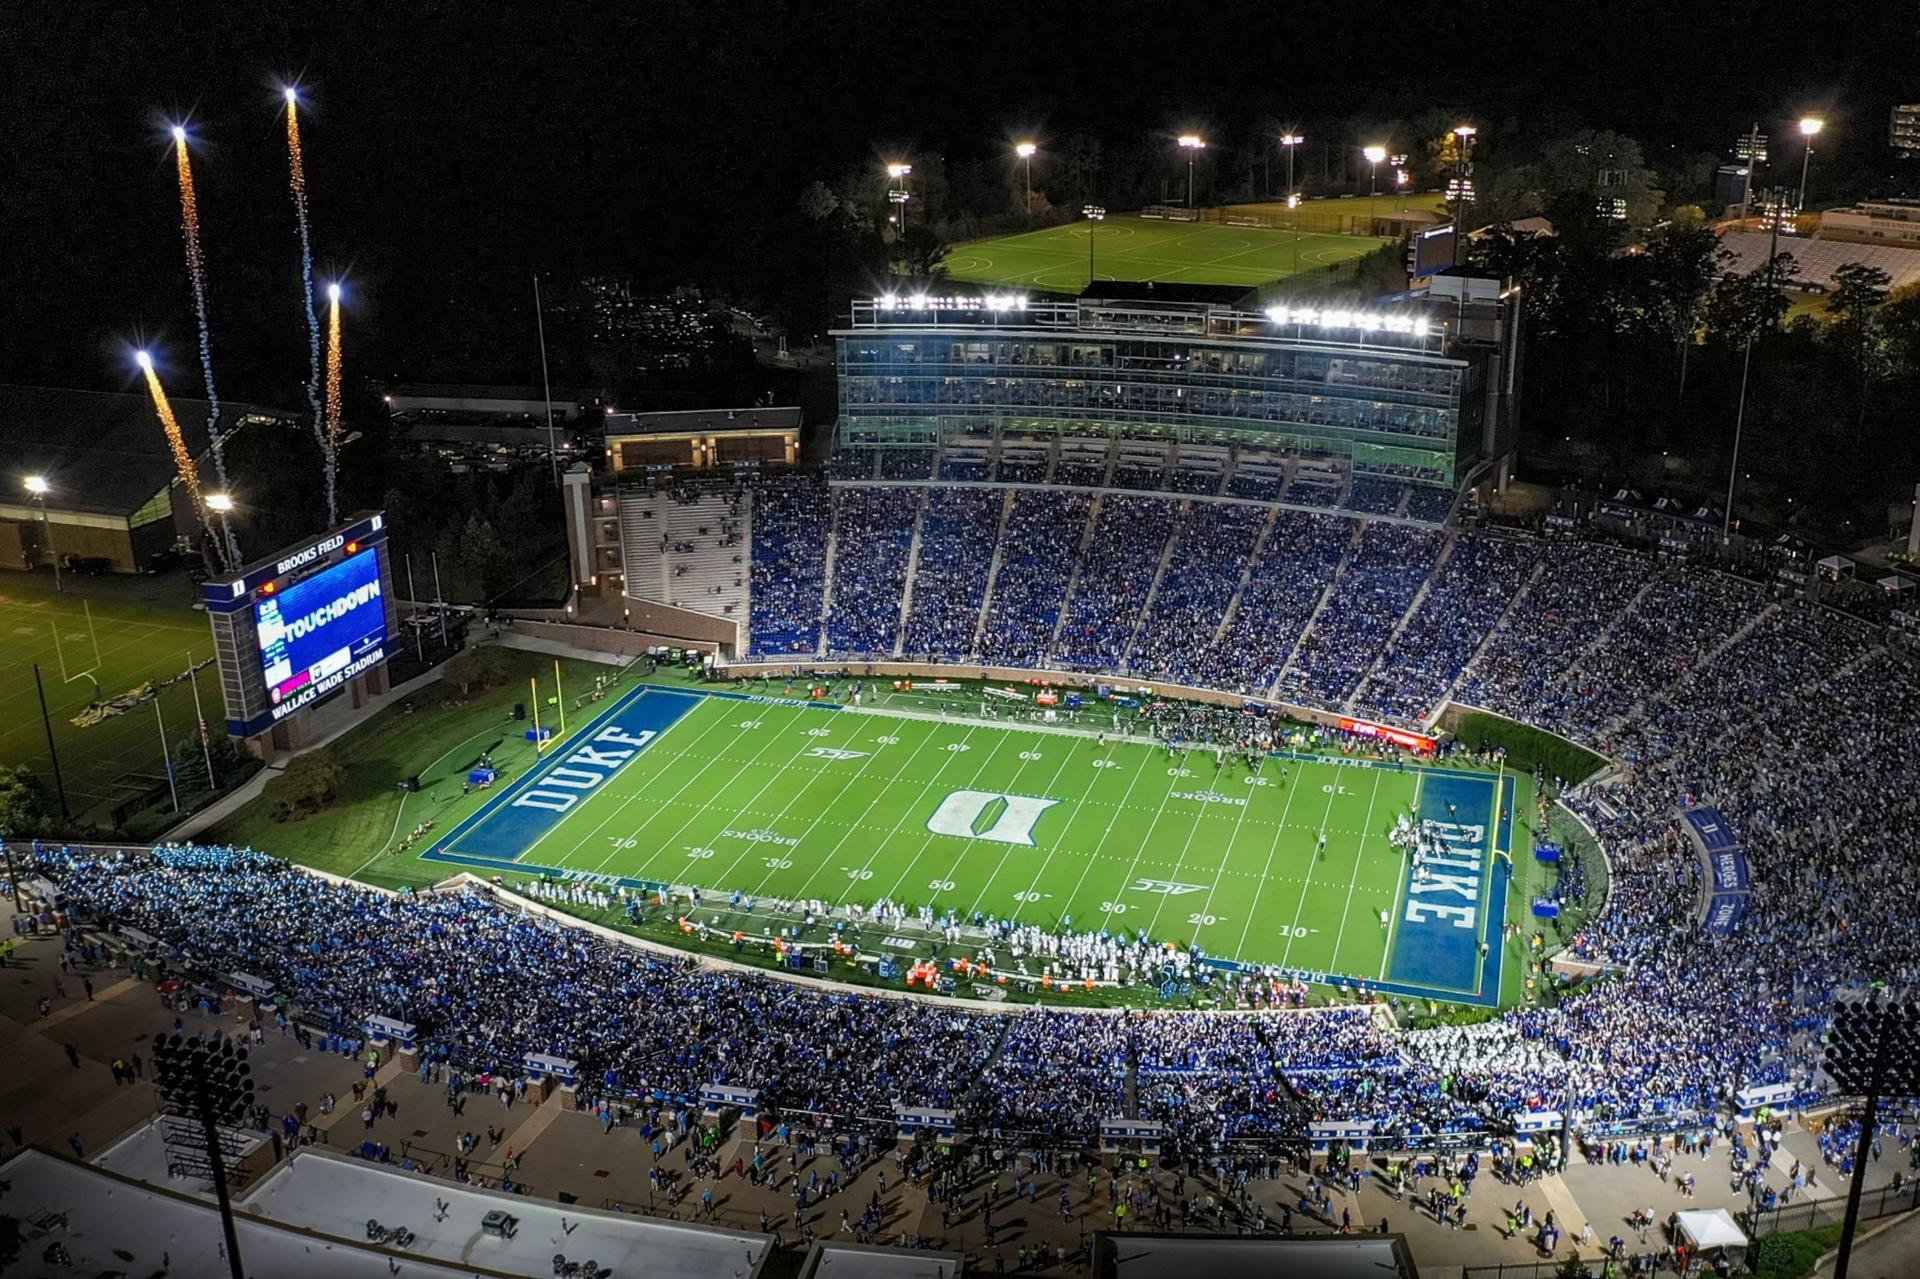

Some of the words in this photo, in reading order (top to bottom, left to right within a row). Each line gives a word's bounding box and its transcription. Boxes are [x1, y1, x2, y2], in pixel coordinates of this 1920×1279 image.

[277, 547, 317, 575] BROOKS
[318, 535, 344, 556] FIELD
[286, 578, 381, 643] TOUCHDOWN
[271, 687, 316, 719] WALLACE
[317, 671, 344, 693] WADE
[344, 648, 383, 678] STADIUM
[740, 720, 763, 730] 10
[808, 728, 831, 737] 20
[877, 735, 900, 745] 30
[802, 747, 872, 760] ACC
[947, 743, 971, 753] 40
[1019, 751, 1042, 761] 50
[511, 726, 657, 813] DUKE
[1092, 759, 1117, 769] 40
[1167, 768, 1191, 777] 30
[1243, 776, 1269, 786] 20
[1322, 784, 1346, 795] 10
[1170, 791, 1247, 806] BROOKS
[924, 789, 1064, 848] D
[611, 838, 638, 849] 10
[722, 830, 800, 846] BROOKS
[687, 847, 714, 859] 20
[766, 858, 793, 869] 30
[847, 869, 873, 880] 40
[1405, 819, 1484, 928] DUKE
[1719, 853, 1738, 888] HEROES
[928, 879, 956, 891] 50
[1128, 878, 1210, 895] ACC
[1012, 890, 1040, 903] 40
[1099, 901, 1126, 914] 30
[1187, 913, 1216, 926] 20
[1713, 904, 1735, 927] ZONE
[1278, 925, 1307, 938] 10
